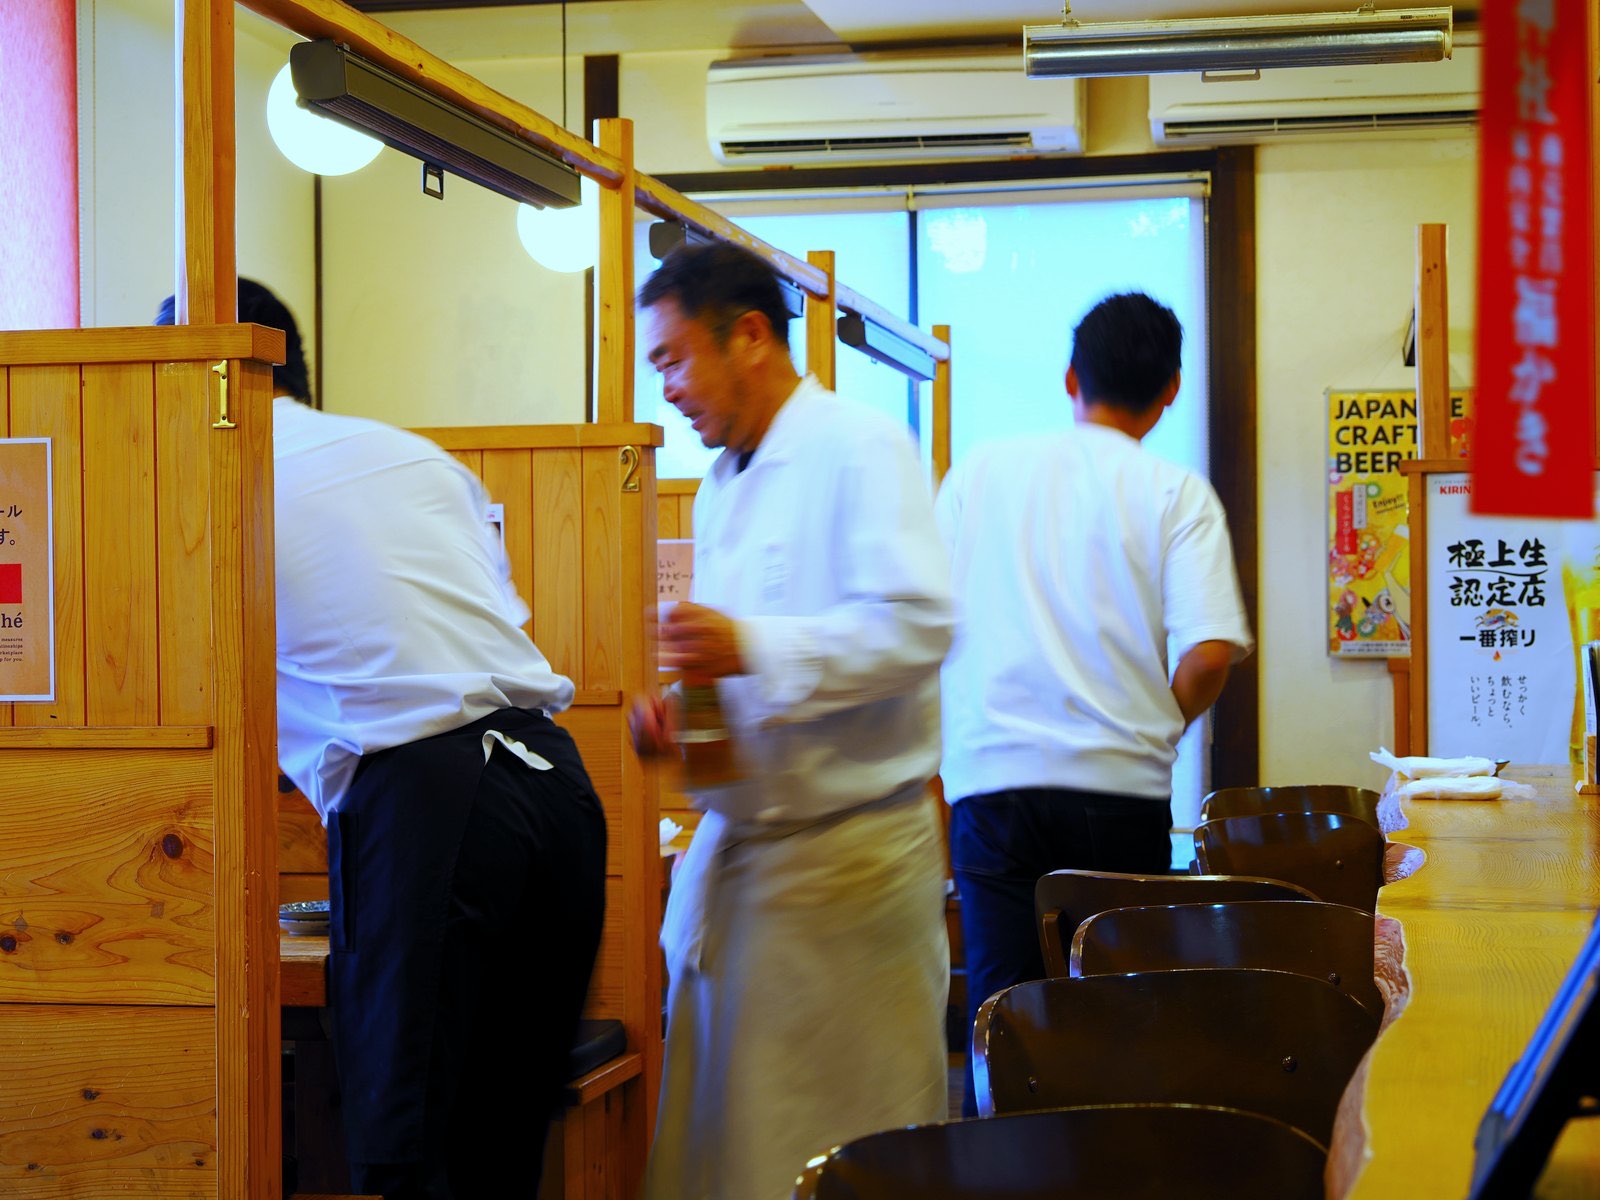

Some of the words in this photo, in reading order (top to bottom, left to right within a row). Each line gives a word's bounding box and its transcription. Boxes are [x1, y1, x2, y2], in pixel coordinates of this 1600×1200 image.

[212, 359, 237, 429] 1
[1335, 398, 1464, 420] JAPANE
[1335, 425, 1418, 446] CRAFT
[619, 445, 640, 493] 2
[1336, 451, 1418, 474] BEER
[1439, 485, 1472, 495] KIRIN
[1446, 537, 1549, 569] 極上生
[1448, 574, 1547, 607] 認定店
[1459, 629, 1536, 648] 一番搾り
[1487, 675, 1496, 717] ちょっと
[1518, 675, 1528, 716] せっかく
